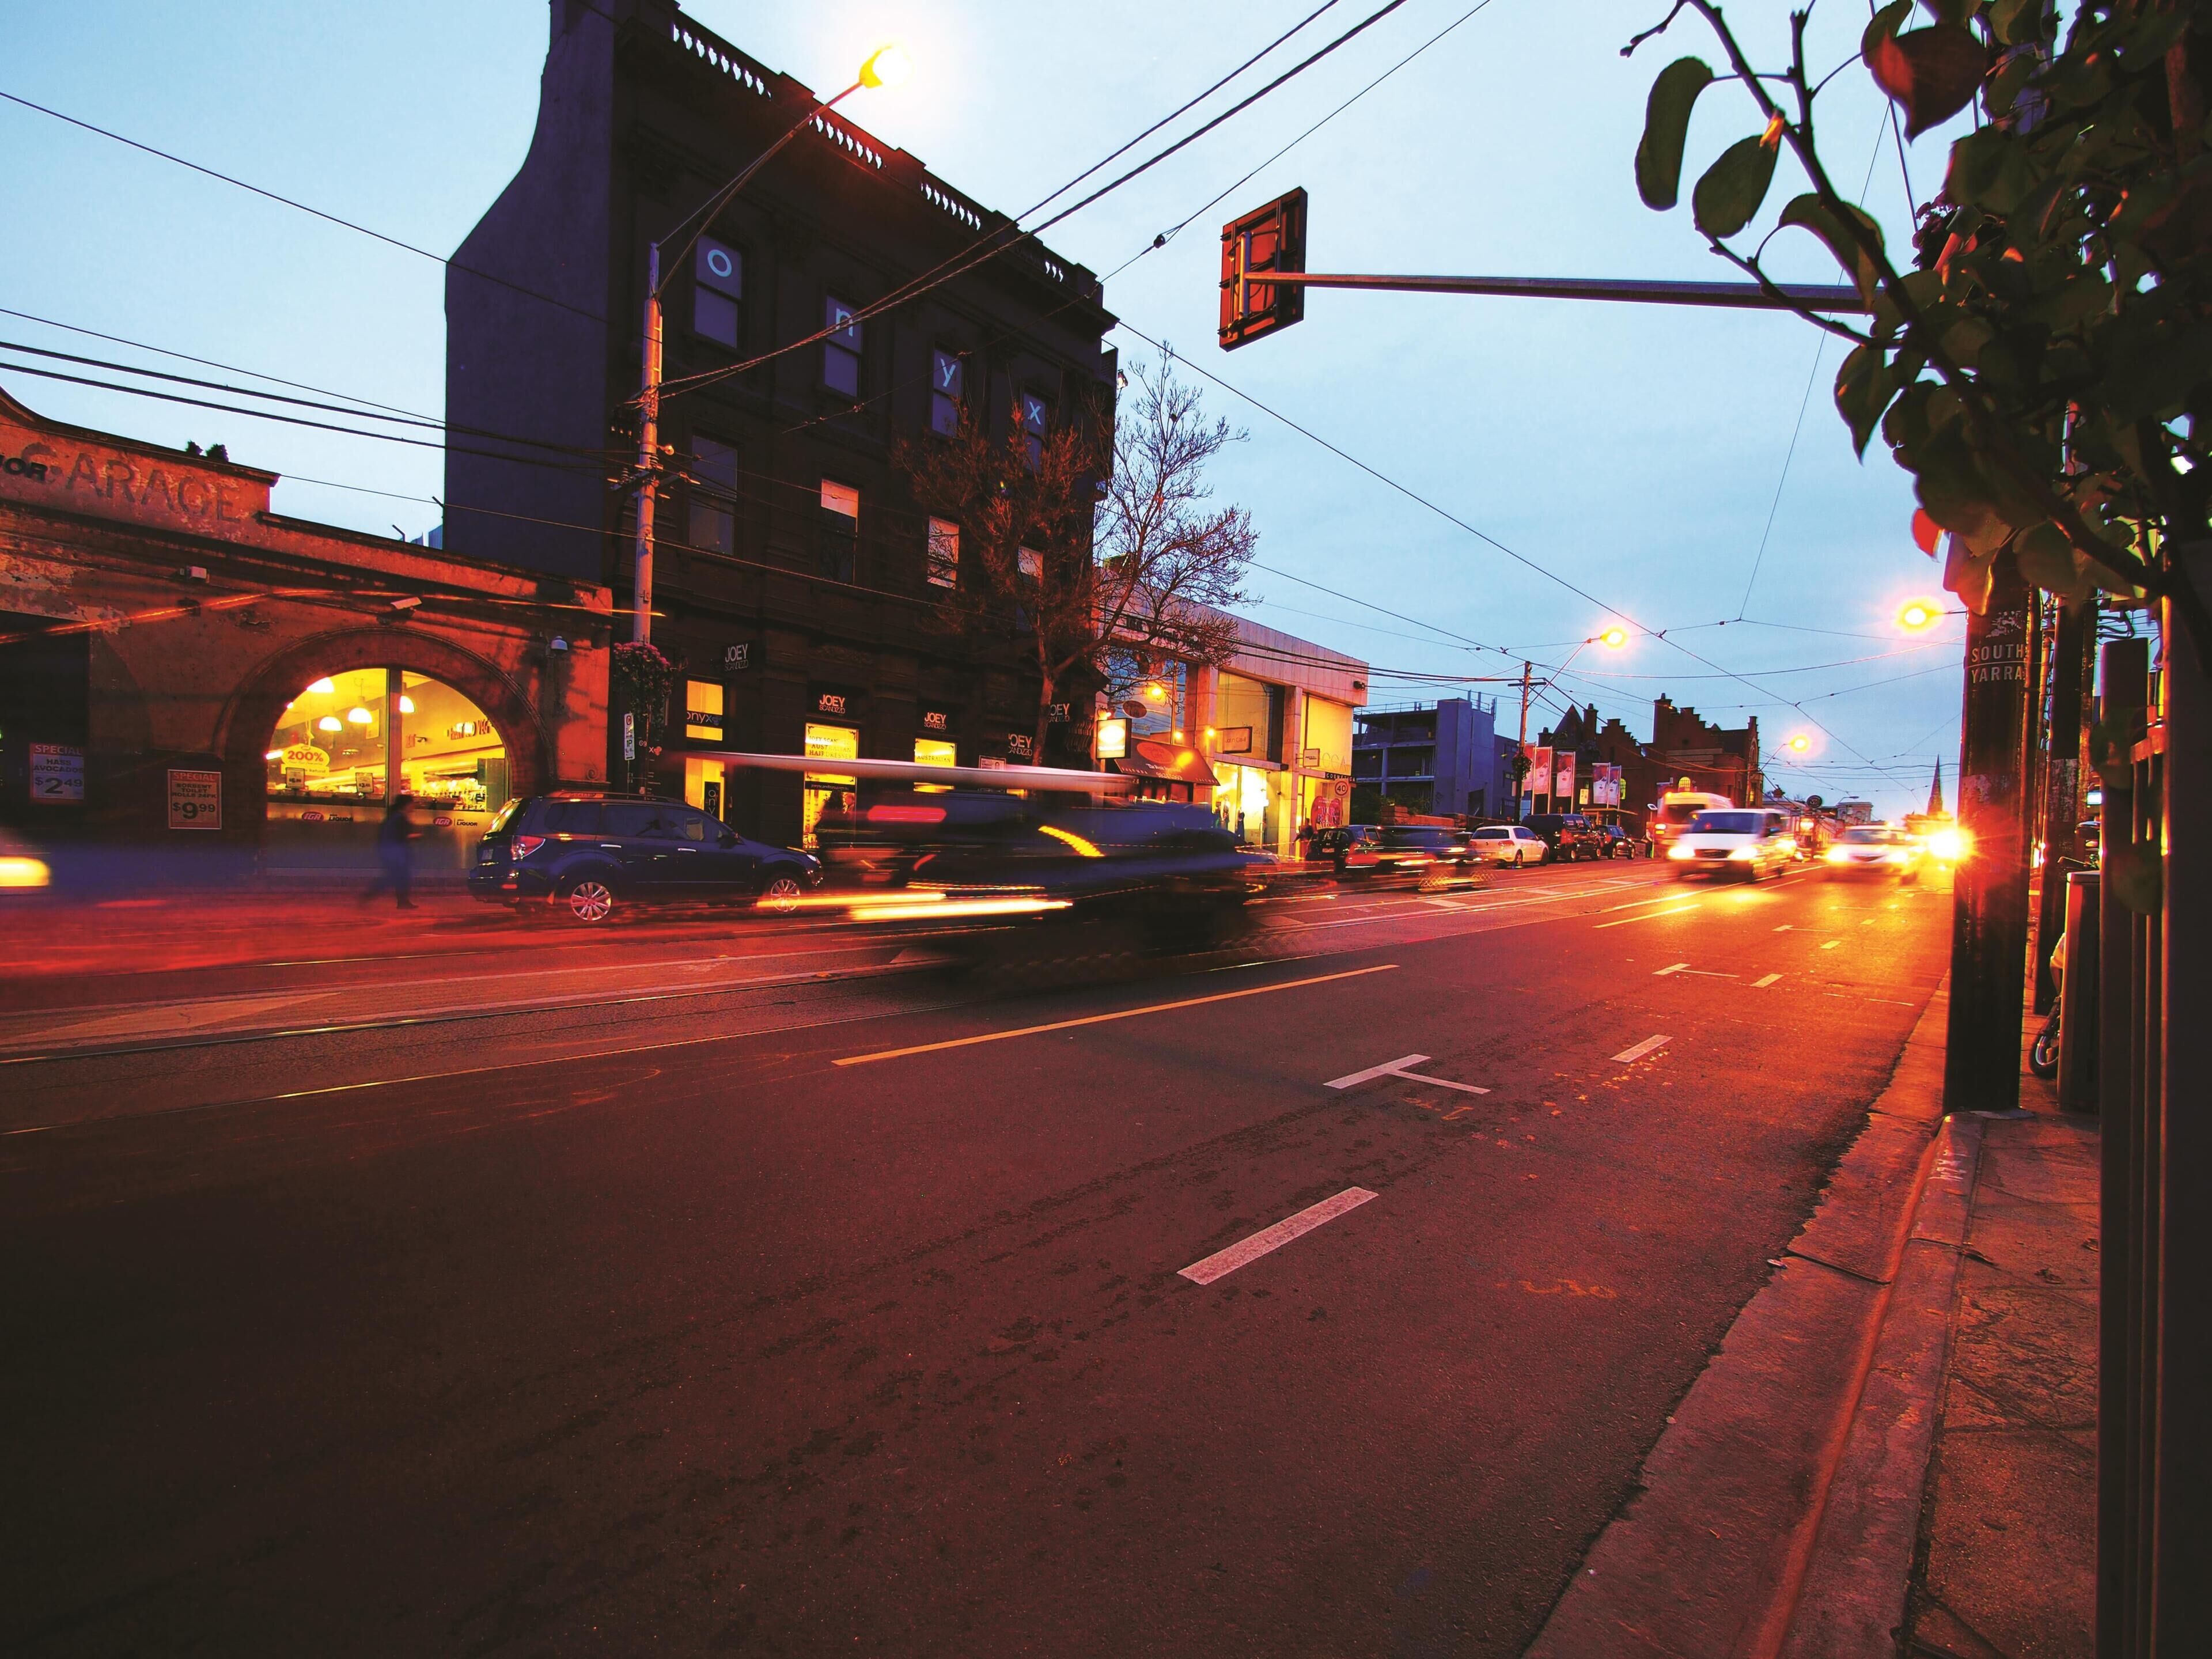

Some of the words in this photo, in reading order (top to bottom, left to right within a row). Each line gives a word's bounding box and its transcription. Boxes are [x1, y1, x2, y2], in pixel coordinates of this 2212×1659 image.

[725, 643, 748, 662] JOEY
[1972, 644, 2024, 662] SOUTH
[1971, 666, 2024, 684] YARRA
[820, 694, 845, 707] JOEY
[1050, 703, 1070, 715] OEY
[924, 712, 946, 724] JOEY
[35, 745, 81, 755] SPECIAL
[287, 751, 324, 762] 200%
[174, 772, 215, 781] SPECIAL
